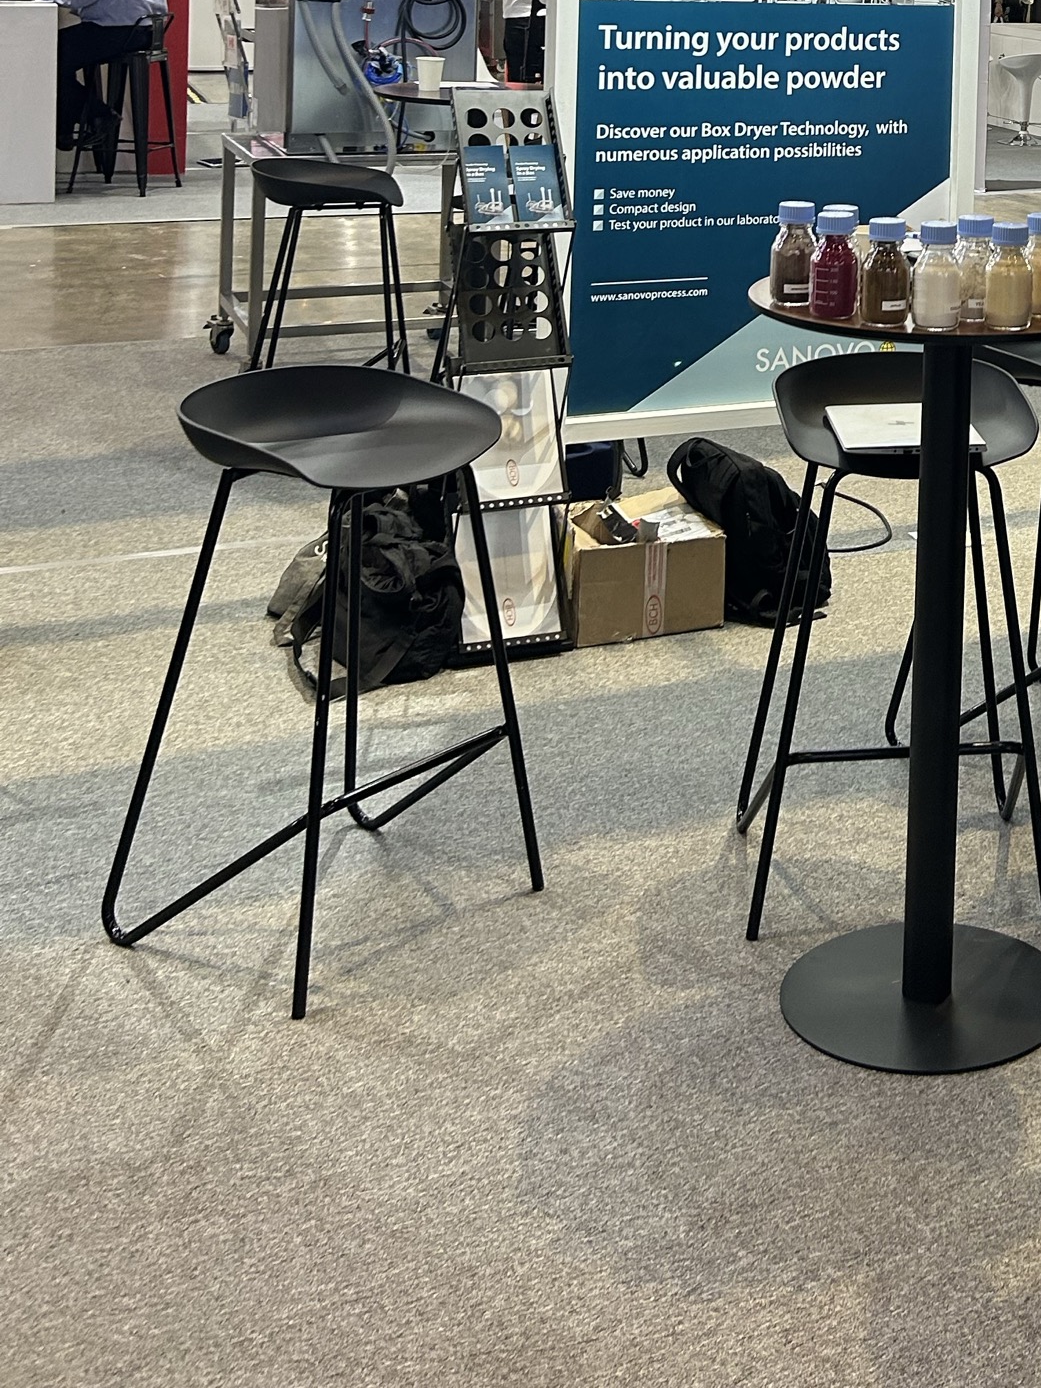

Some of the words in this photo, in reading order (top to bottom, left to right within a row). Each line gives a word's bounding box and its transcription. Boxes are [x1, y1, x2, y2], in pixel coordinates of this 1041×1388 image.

[598, 24, 710, 57] Turning
[715, 31, 780, 57] your
[785, 26, 900, 57] products
[598, 64, 655, 90] into
[661, 64, 780, 90] valuable
[786, 64, 886, 96] powder
[596, 123, 667, 140] Discover
[669, 125, 698, 138] our
[701, 122, 731, 137] Box
[734, 121, 779, 141] Dryer
[779, 120, 870, 139] Technology,
[876, 119, 908, 135] with
[595, 148, 679, 163] numerous
[681, 144, 770, 164] application
[773, 142, 862, 162] possibilities
[609, 188, 636, 200] Save
[638, 187, 676, 201] money
[609, 203, 658, 216] Compact
[660, 202, 697, 214] design
[609, 219, 631, 230] Test
[632, 220, 658, 232] your
[659, 216, 702, 231] product
[704, 216, 714, 227] in
[716, 217, 734, 226] our
[590, 288, 708, 303] www.sanovoprocess.com
[648, 603, 658, 626] BCH
